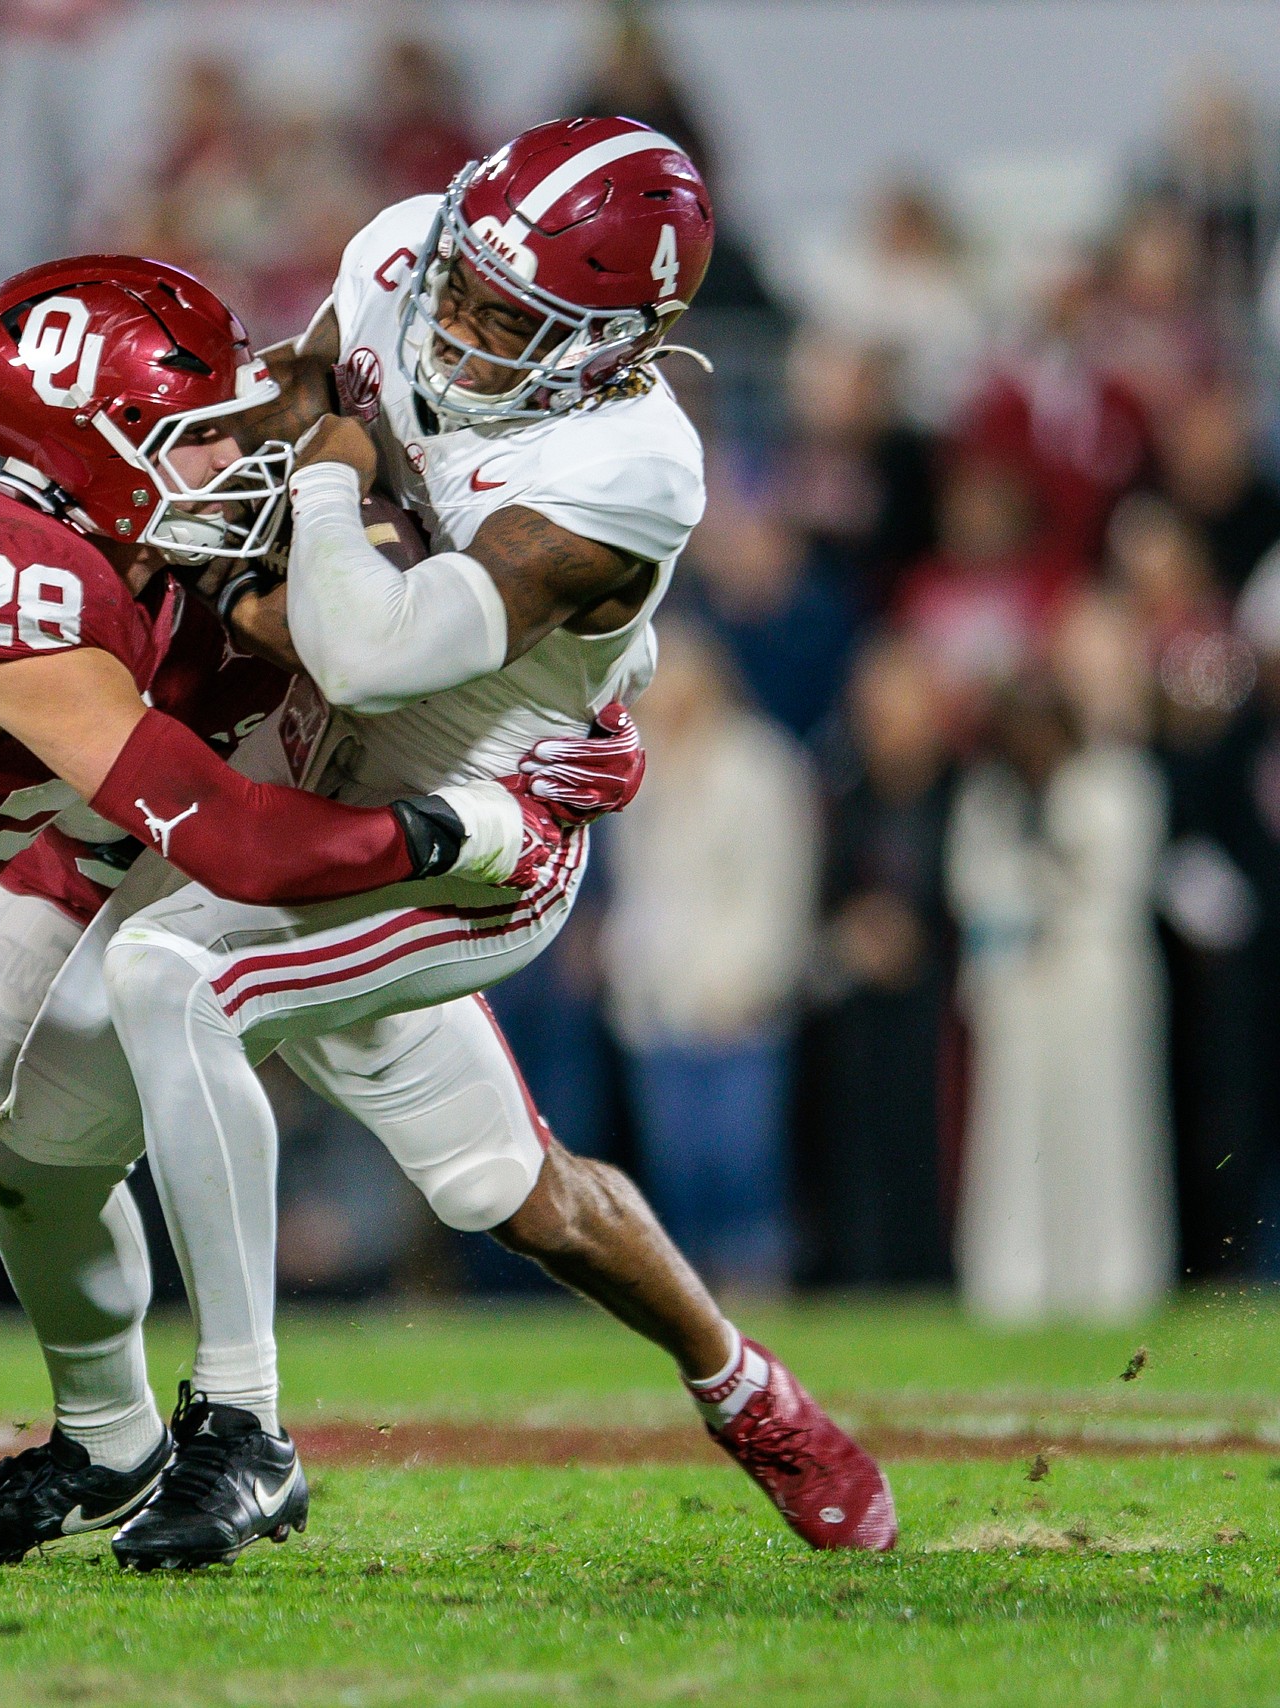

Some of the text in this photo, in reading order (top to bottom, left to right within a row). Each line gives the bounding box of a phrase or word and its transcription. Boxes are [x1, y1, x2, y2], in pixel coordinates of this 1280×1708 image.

[373, 247, 418, 292] C
[650, 223, 680, 298] 4
[17, 295, 106, 409] OU
